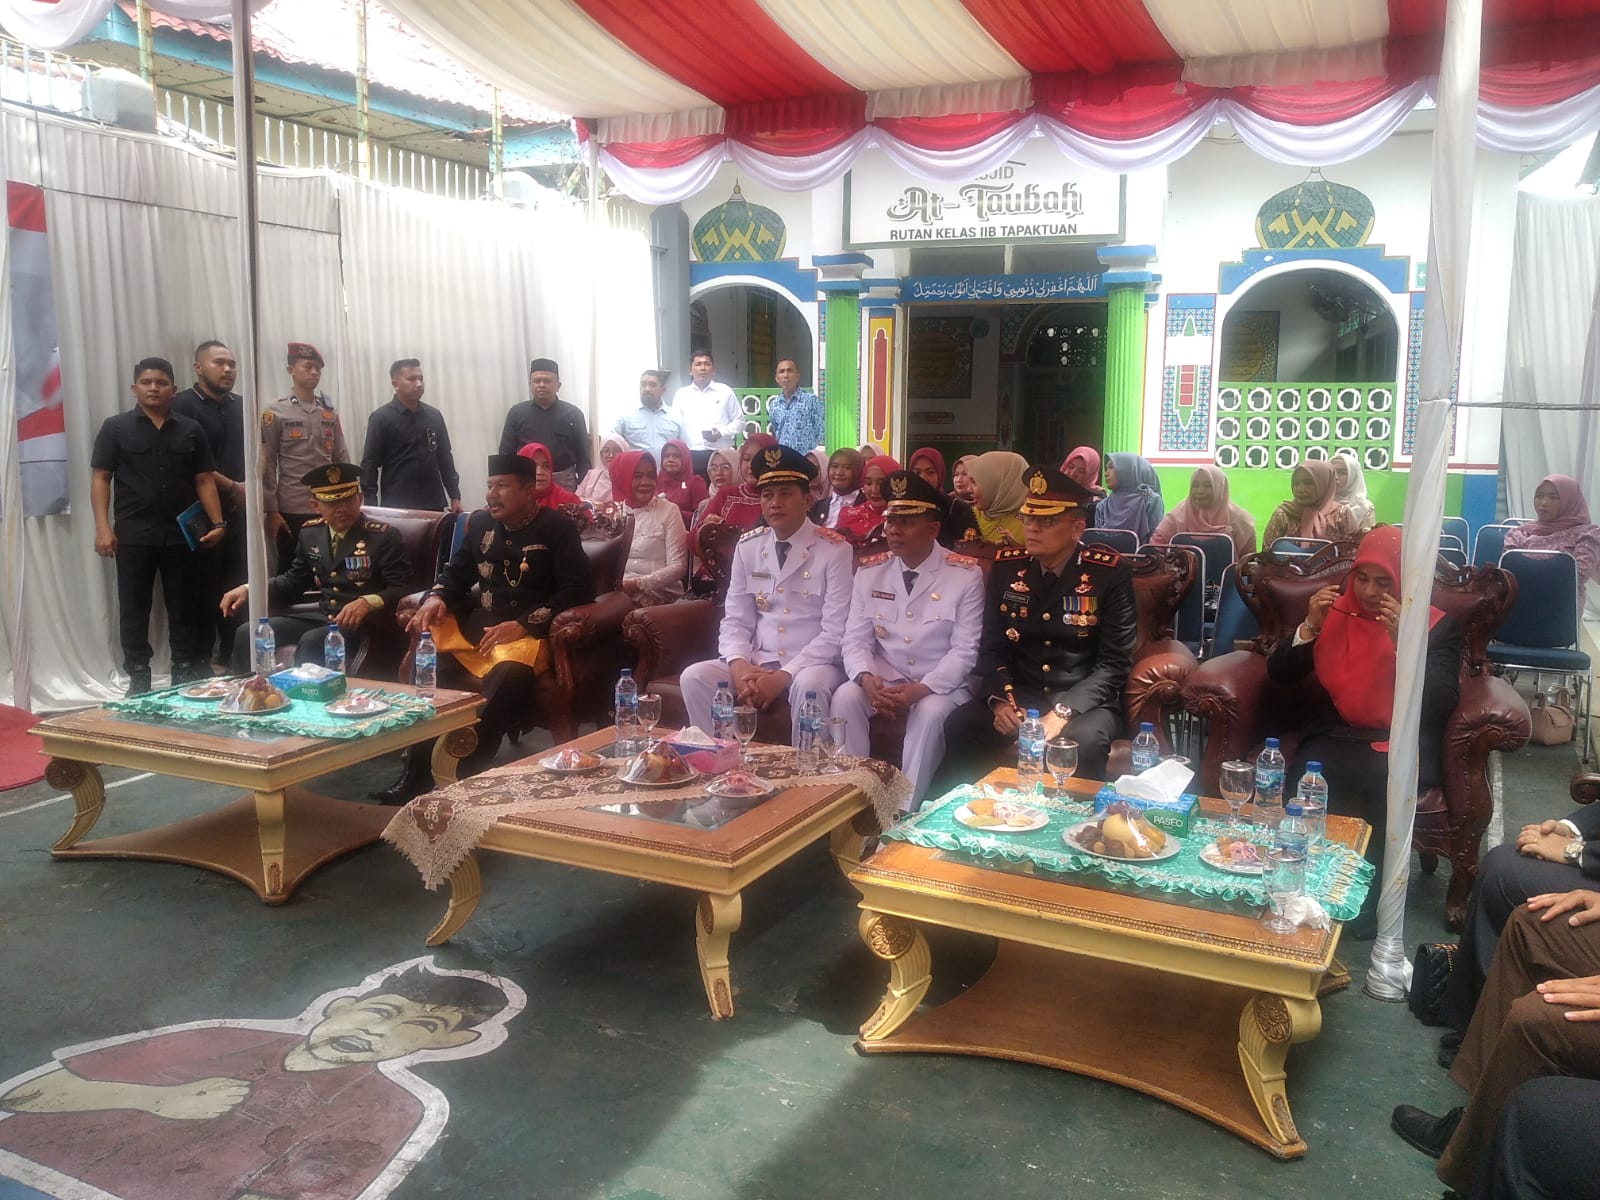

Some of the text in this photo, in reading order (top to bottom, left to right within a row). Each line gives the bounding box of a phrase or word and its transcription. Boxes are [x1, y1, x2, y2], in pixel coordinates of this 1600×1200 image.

[959, 182, 1084, 222] Taubah
[890, 223, 1077, 240] RUTAN KELAS IIB TAPAKTUAN
[1153, 815, 1183, 828] PASEO
